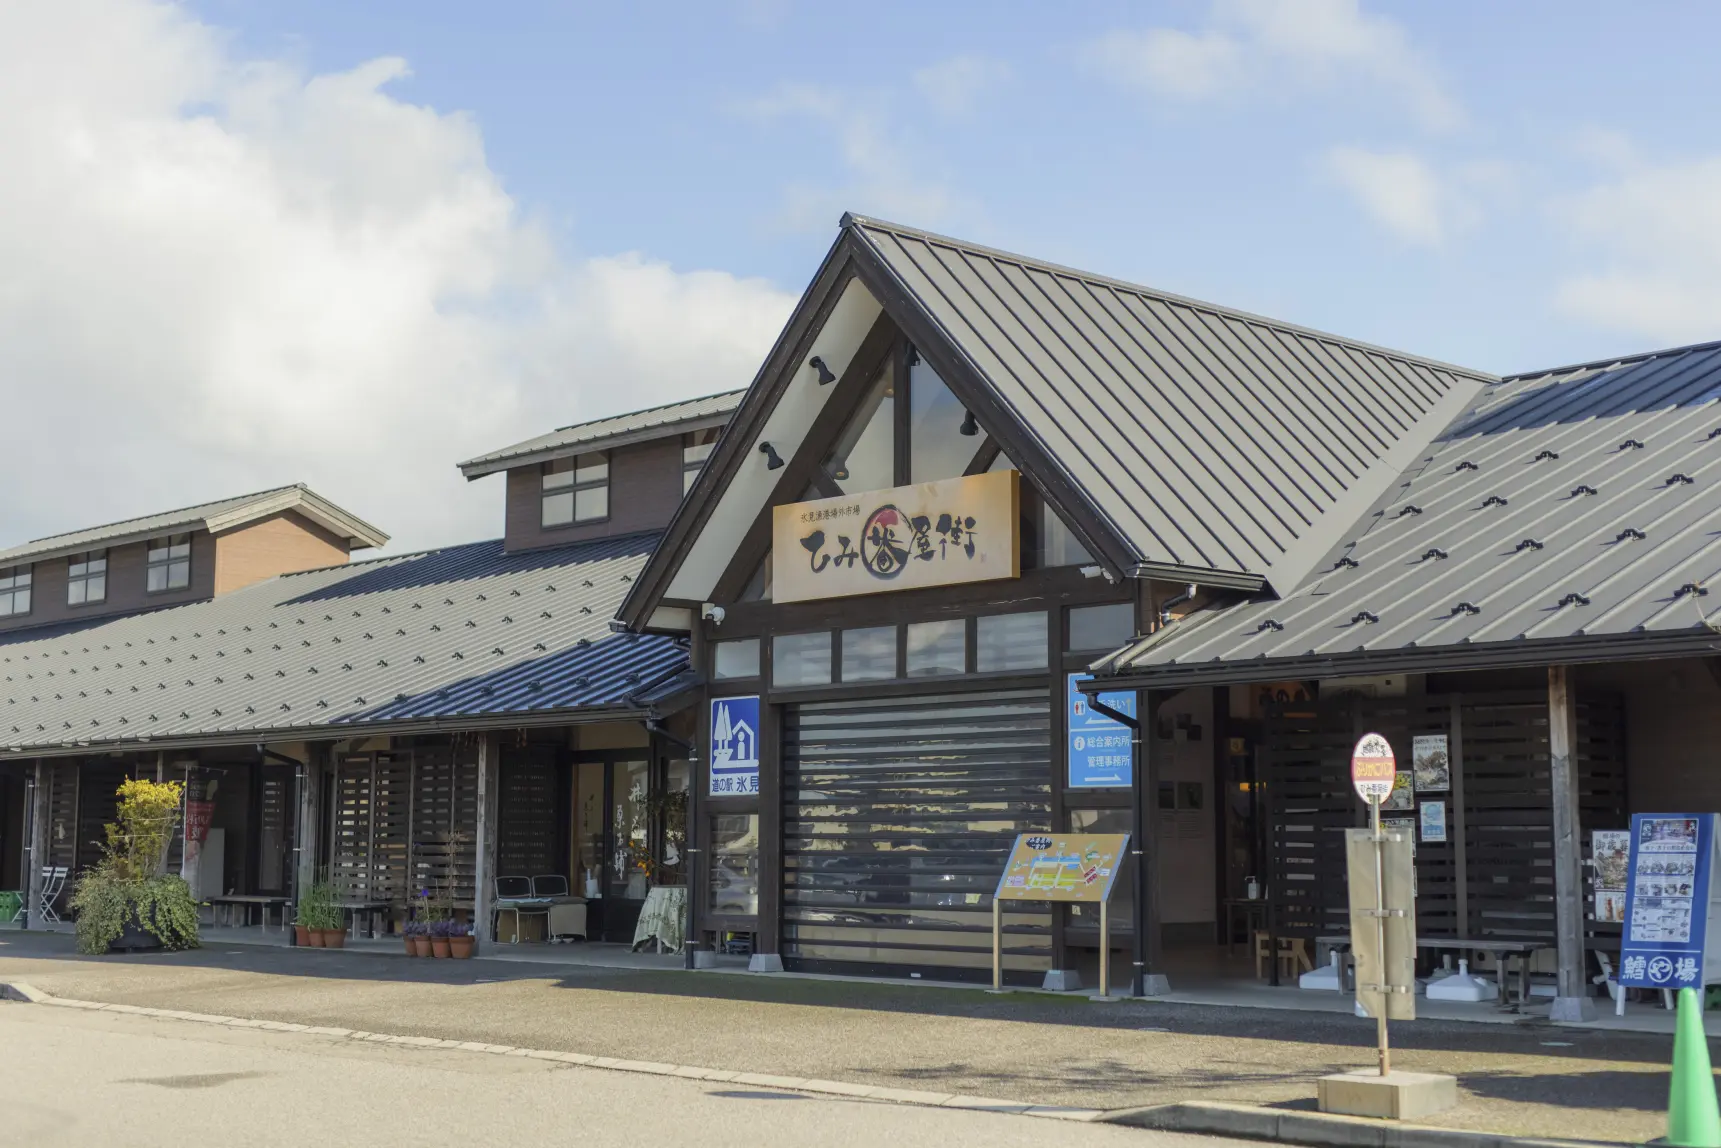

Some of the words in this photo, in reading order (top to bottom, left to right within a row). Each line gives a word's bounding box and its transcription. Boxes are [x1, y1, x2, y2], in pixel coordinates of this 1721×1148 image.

[801, 505, 861, 524] 氷見漁港場外市場
[800, 504, 978, 581] ひみ番屋街
[1087, 736, 1130, 748] 総合案内所
[1087, 756, 1130, 768] 管理事務所
[712, 778, 733, 793] 道の駅
[736, 776, 759, 793] 氷見
